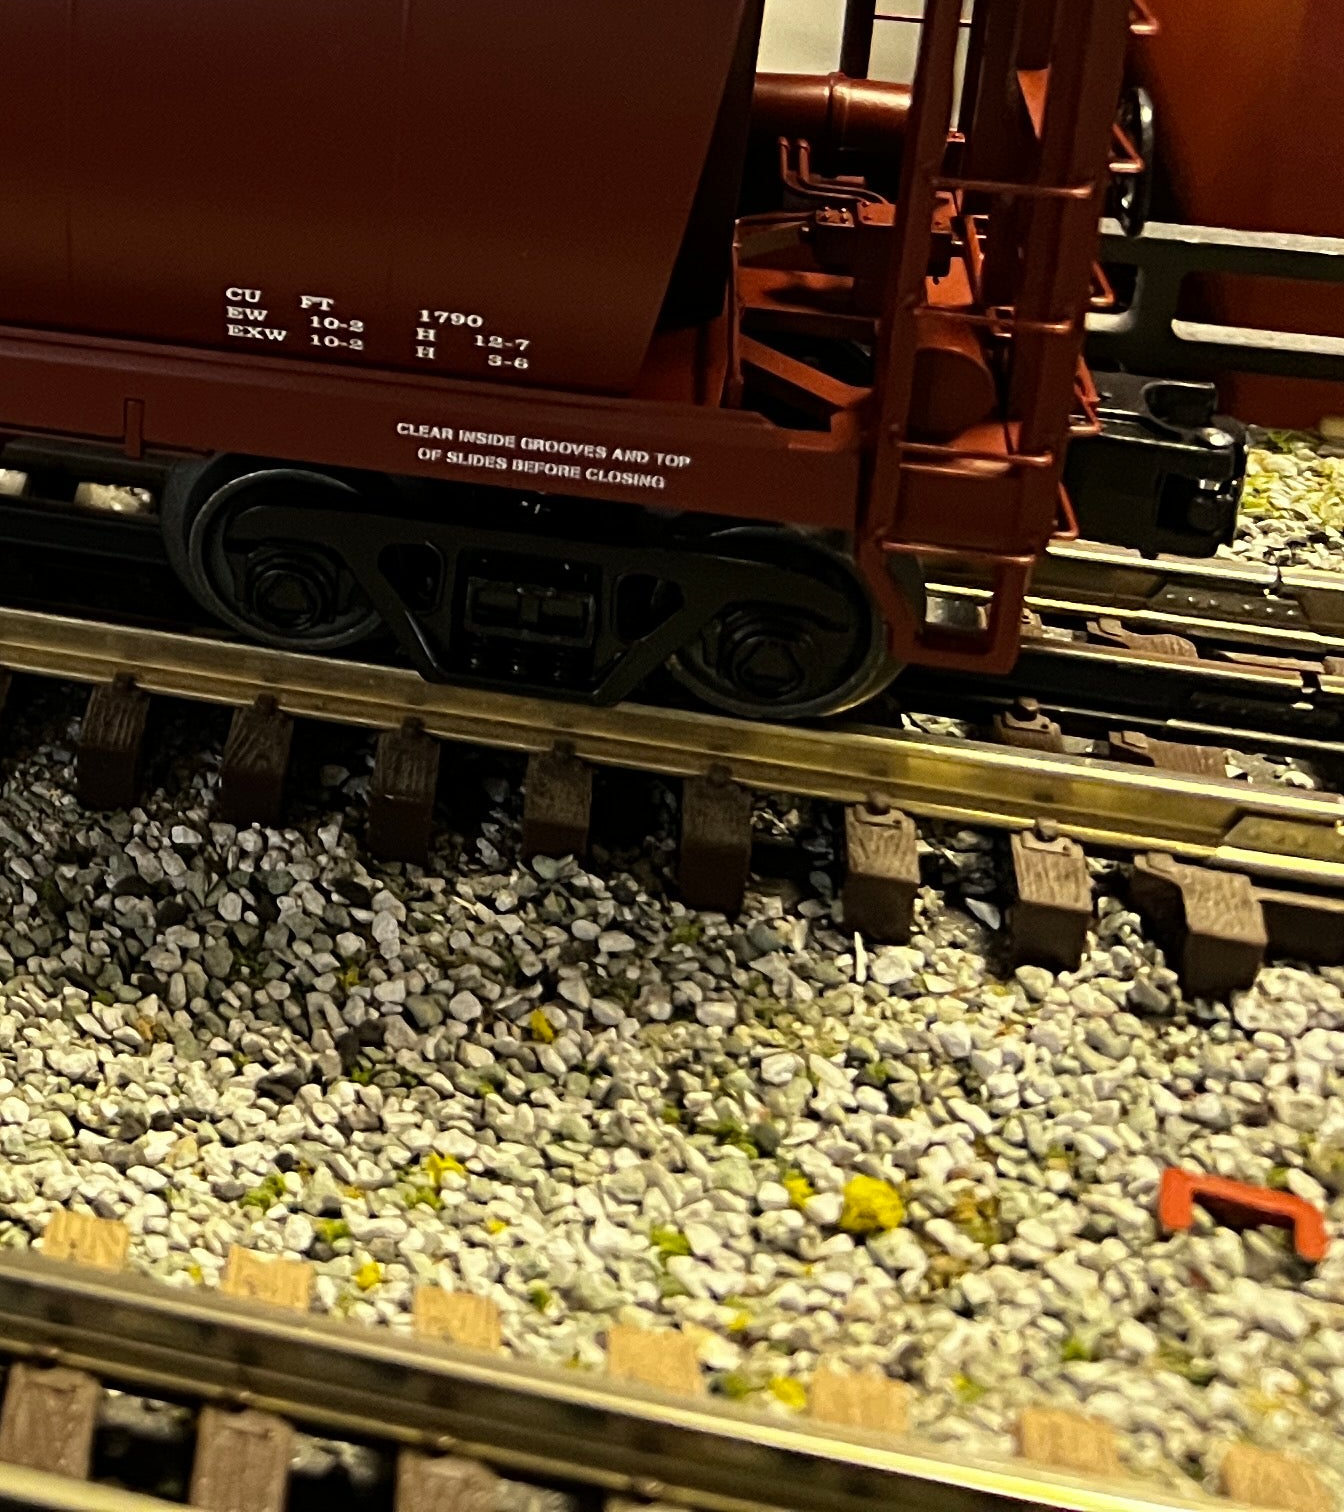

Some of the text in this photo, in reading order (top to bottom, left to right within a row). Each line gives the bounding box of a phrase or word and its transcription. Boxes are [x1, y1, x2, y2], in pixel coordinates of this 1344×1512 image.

[225, 287, 483, 328] CU FT 1790
[226, 306, 530, 351] EW 10-2 H 12-7
[226, 324, 287, 342] EXW
[310, 334, 364, 351] 10-2
[416, 345, 436, 360] H
[397, 422, 692, 468] CLEAR INSIDE GROOVES AND TOP
[417, 447, 666, 489] OF SLIDES BEFORE CLOSING
